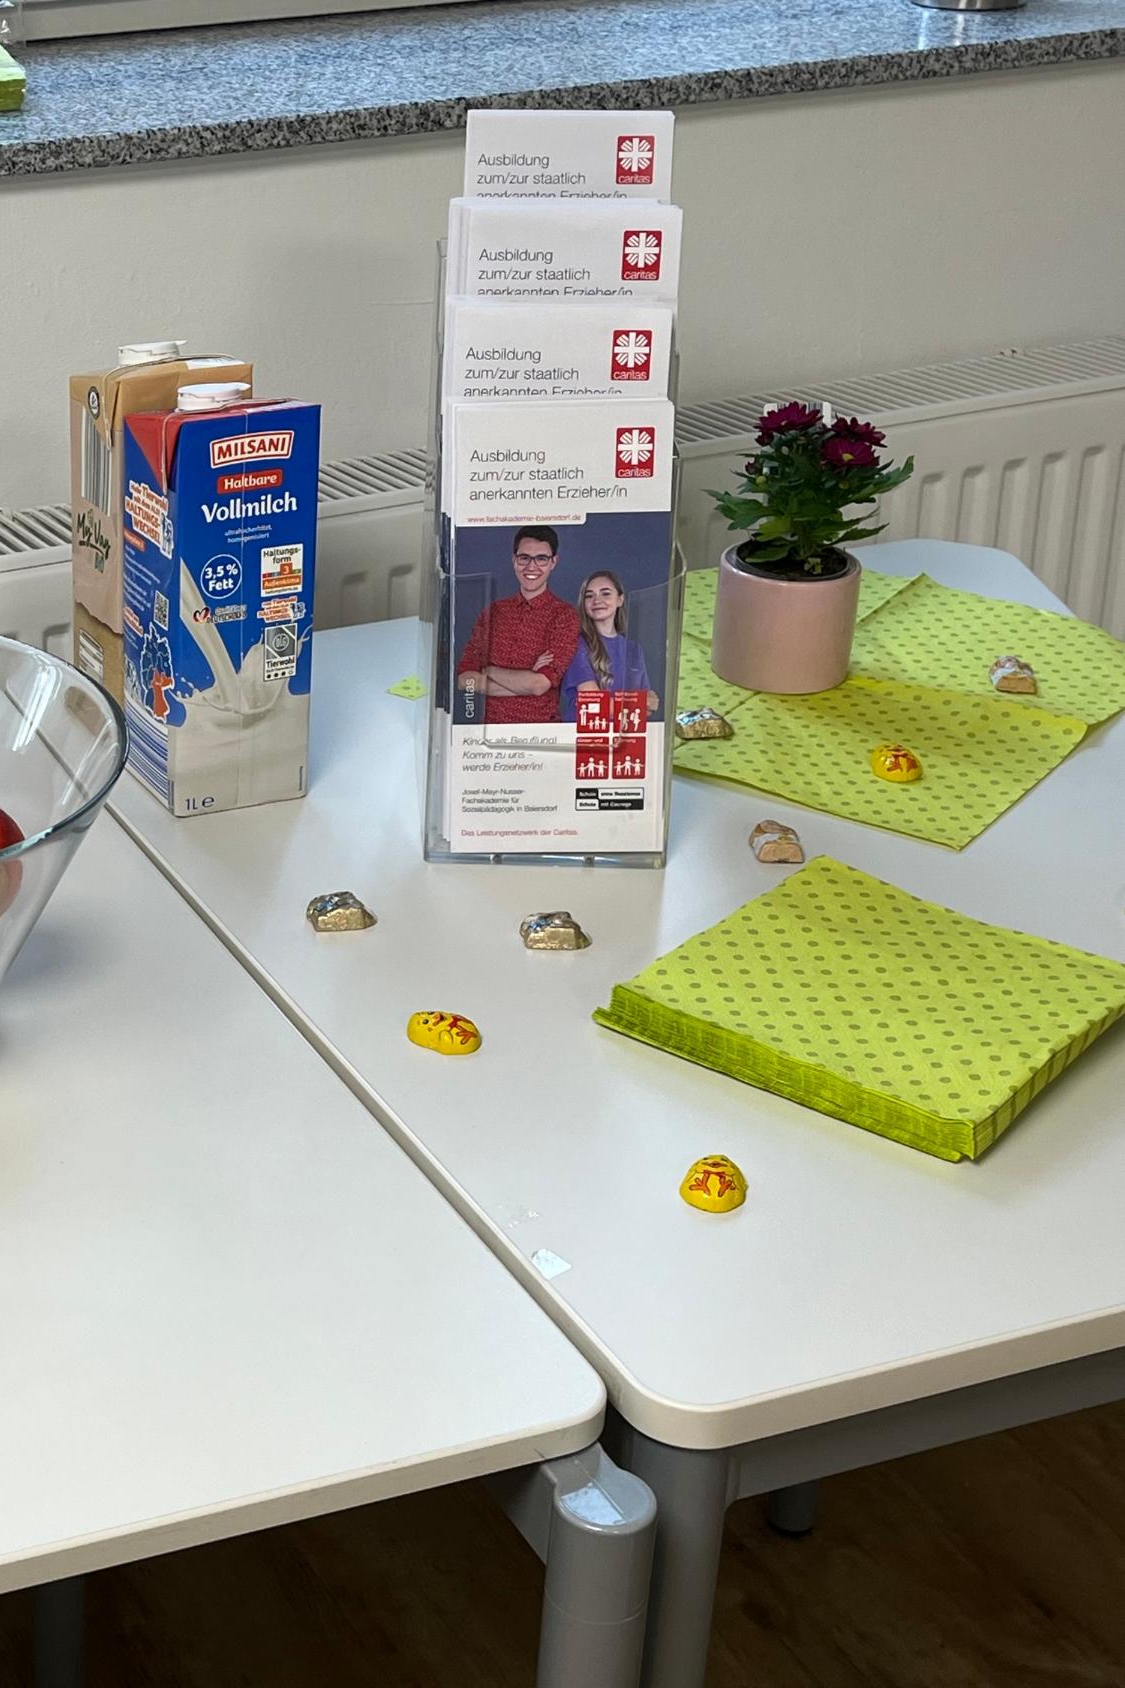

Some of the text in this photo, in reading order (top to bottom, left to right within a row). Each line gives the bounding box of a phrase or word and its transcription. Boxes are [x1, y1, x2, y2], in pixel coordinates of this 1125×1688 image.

[477, 153, 550, 169] Ausbildung
[477, 172, 586, 185] zum/zur staatlich
[618, 173, 651, 184] caritas
[479, 248, 553, 264] Ausbildung
[478, 268, 590, 280] zum/zur staatlich
[623, 269, 657, 280] caritas
[465, 347, 541, 363] Ausbildung
[464, 367, 579, 380] zum/zur staatlich
[613, 369, 647, 380] caritas
[217, 437, 286, 460] MILSANI
[470, 449, 546, 464] Ausbildung
[469, 467, 584, 482] zum/zur staatlich
[618, 467, 651, 477] caritas
[224, 474, 277, 490] Haltbare
[469, 485, 628, 501] anerkannten Erzieher/in
[201, 491, 298, 523] Vollmilch
[77, 512, 93, 547] My
[263, 547, 301, 557] Haltungs-
[272, 555, 292, 565] form
[204, 563, 239, 580] 3,5 %
[283, 565, 290, 574] 3
[208, 578, 235, 592] Fett
[465, 678, 475, 718] caritas
[462, 750, 493, 760] Komm
[495, 752, 506, 760] zu
[508, 751, 526, 760] uns
[462, 763, 491, 772] werde
[185, 797, 198, 811] 1L
[460, 829, 475, 837] Das
[540, 828, 551, 836] der
